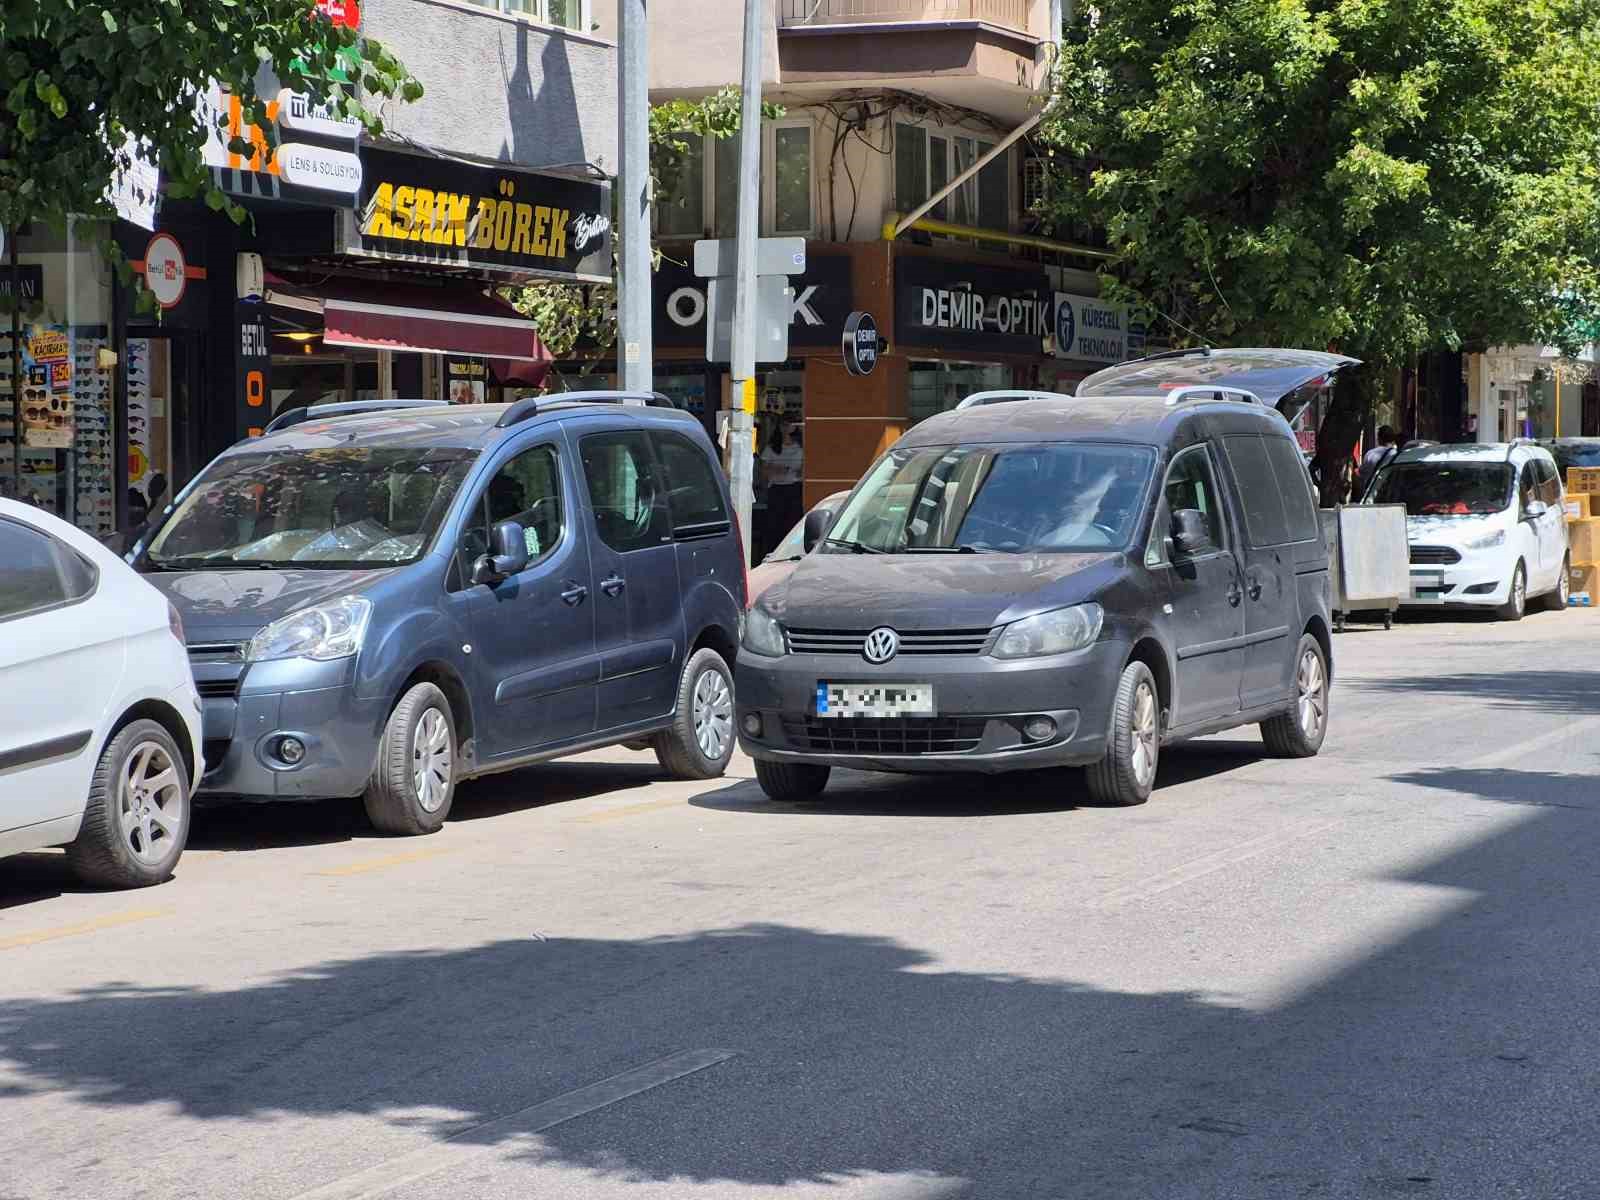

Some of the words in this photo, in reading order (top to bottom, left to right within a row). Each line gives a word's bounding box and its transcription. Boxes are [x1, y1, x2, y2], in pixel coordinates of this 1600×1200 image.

[290, 156, 311, 172] LENS
[474, 178, 570, 258] BÖREK
[922, 282, 984, 331] DEMİR
[996, 290, 1050, 336] OPTİK
[241, 314, 267, 356] BETÜL
